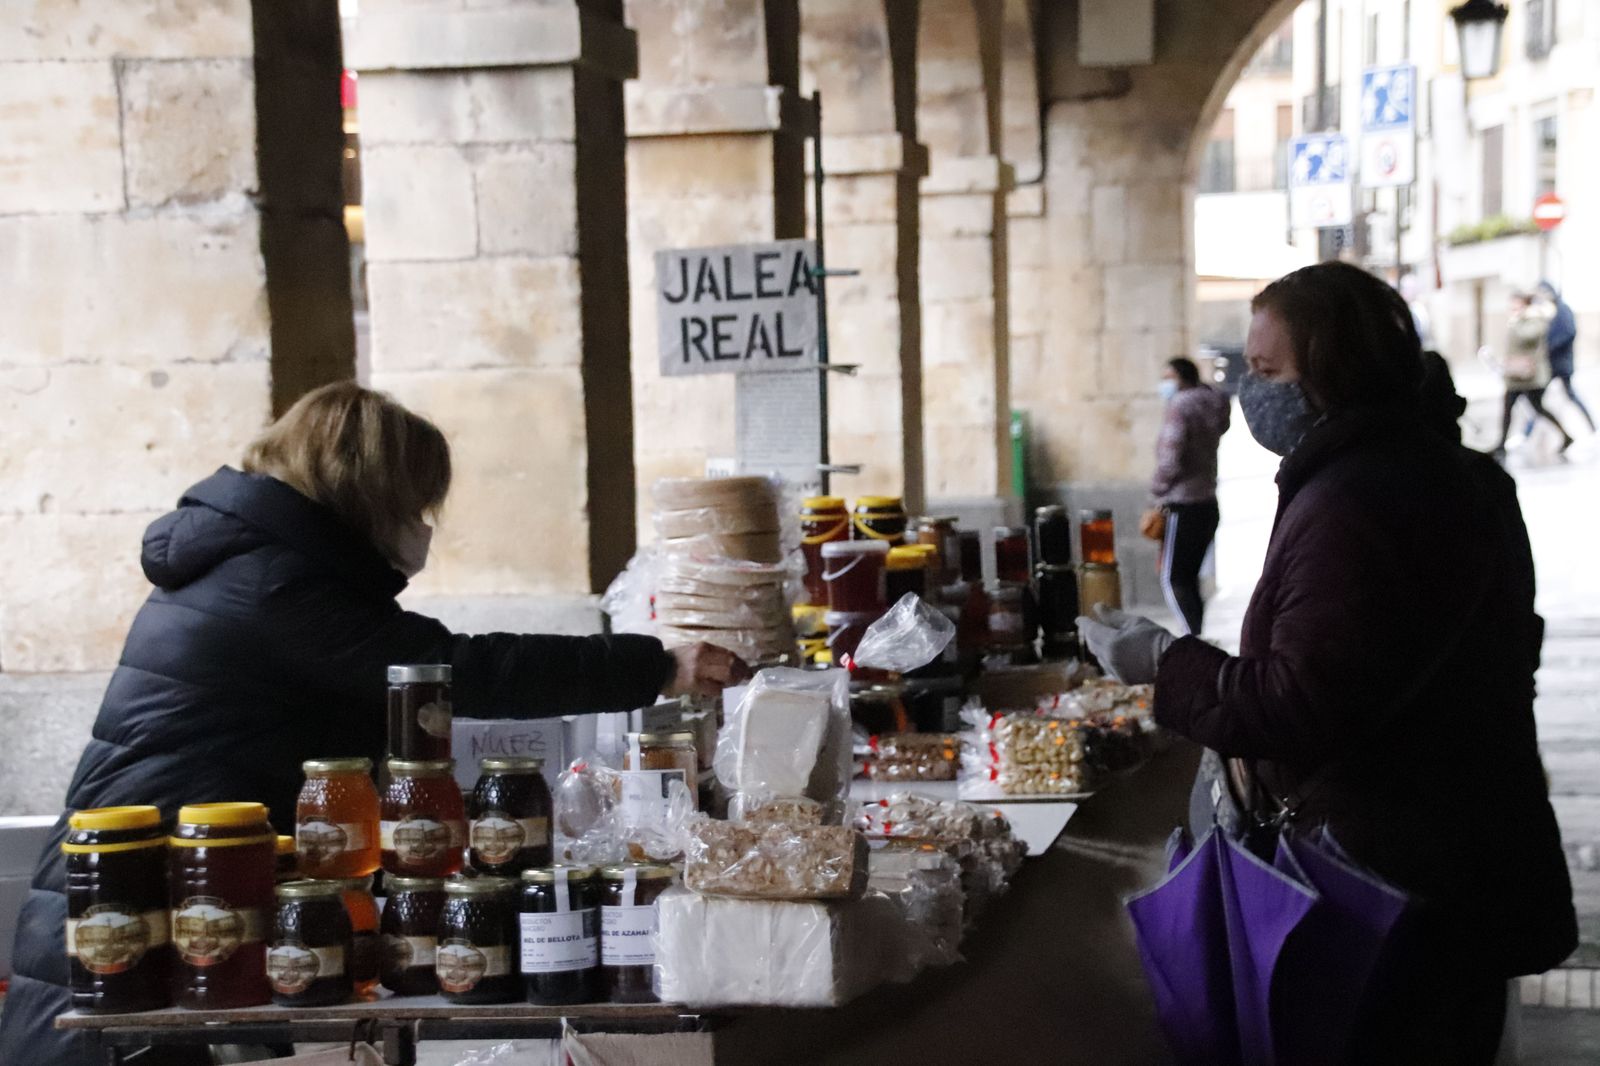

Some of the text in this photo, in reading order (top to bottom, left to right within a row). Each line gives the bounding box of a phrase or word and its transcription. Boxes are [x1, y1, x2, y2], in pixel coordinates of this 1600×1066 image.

[663, 250, 818, 304] JALEA
[681, 311, 803, 364] REAL
[547, 934, 581, 943] BELLOTA
